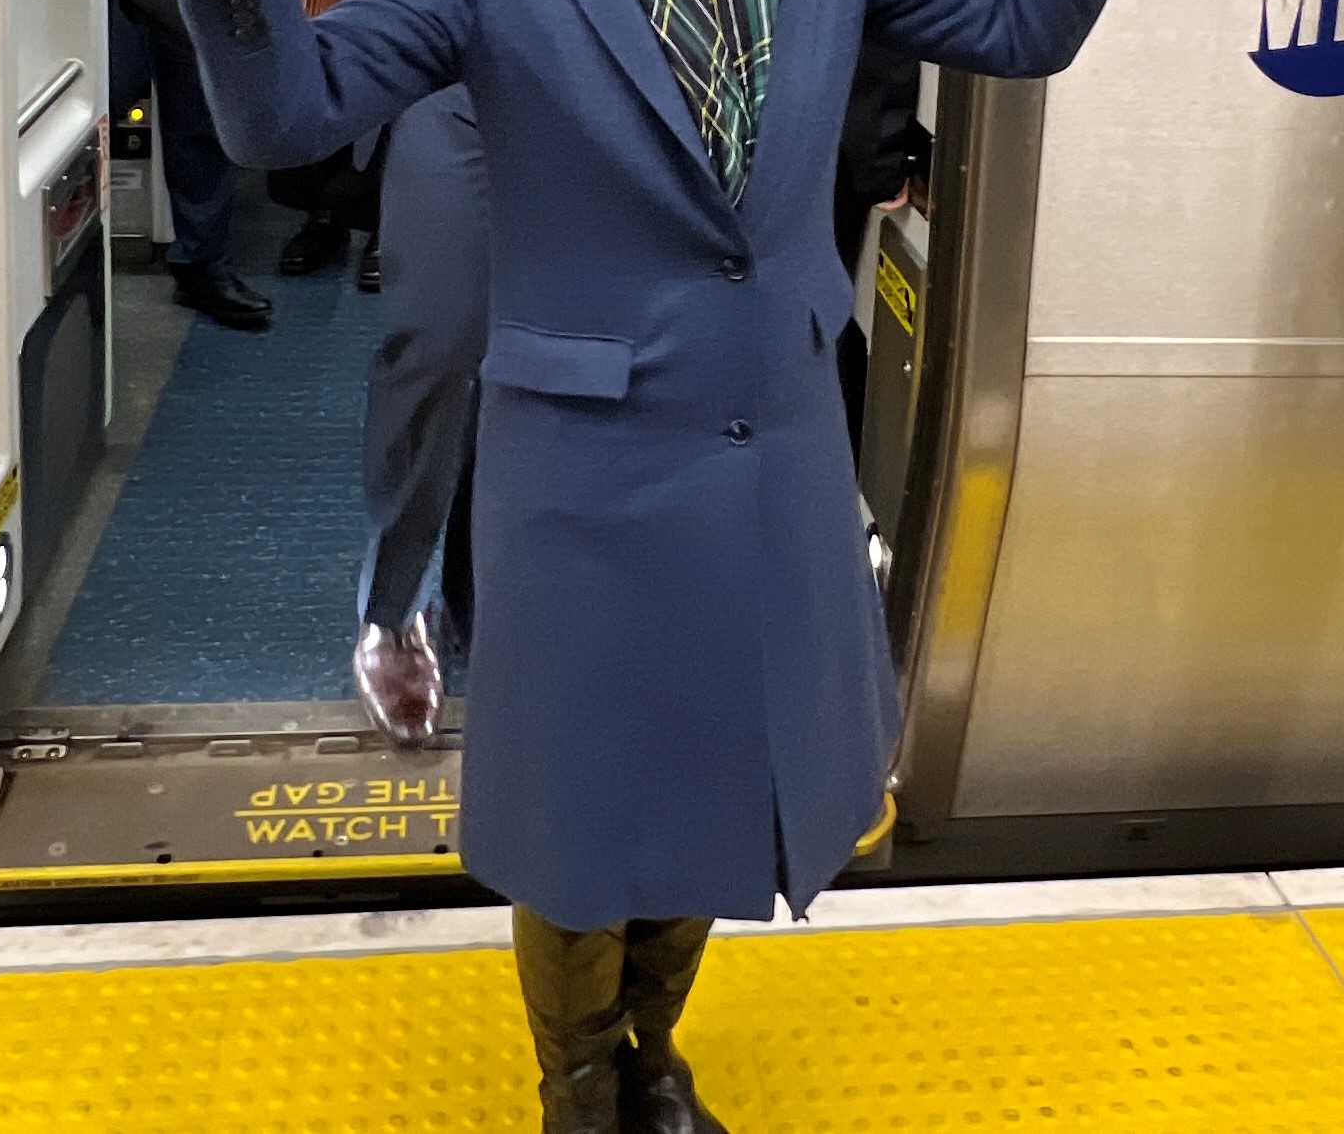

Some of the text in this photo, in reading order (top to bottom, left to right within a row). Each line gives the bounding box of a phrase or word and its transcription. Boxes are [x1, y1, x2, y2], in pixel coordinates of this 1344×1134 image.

[249, 779, 455, 807] THE GAP
[246, 815, 408, 844] WATCH
